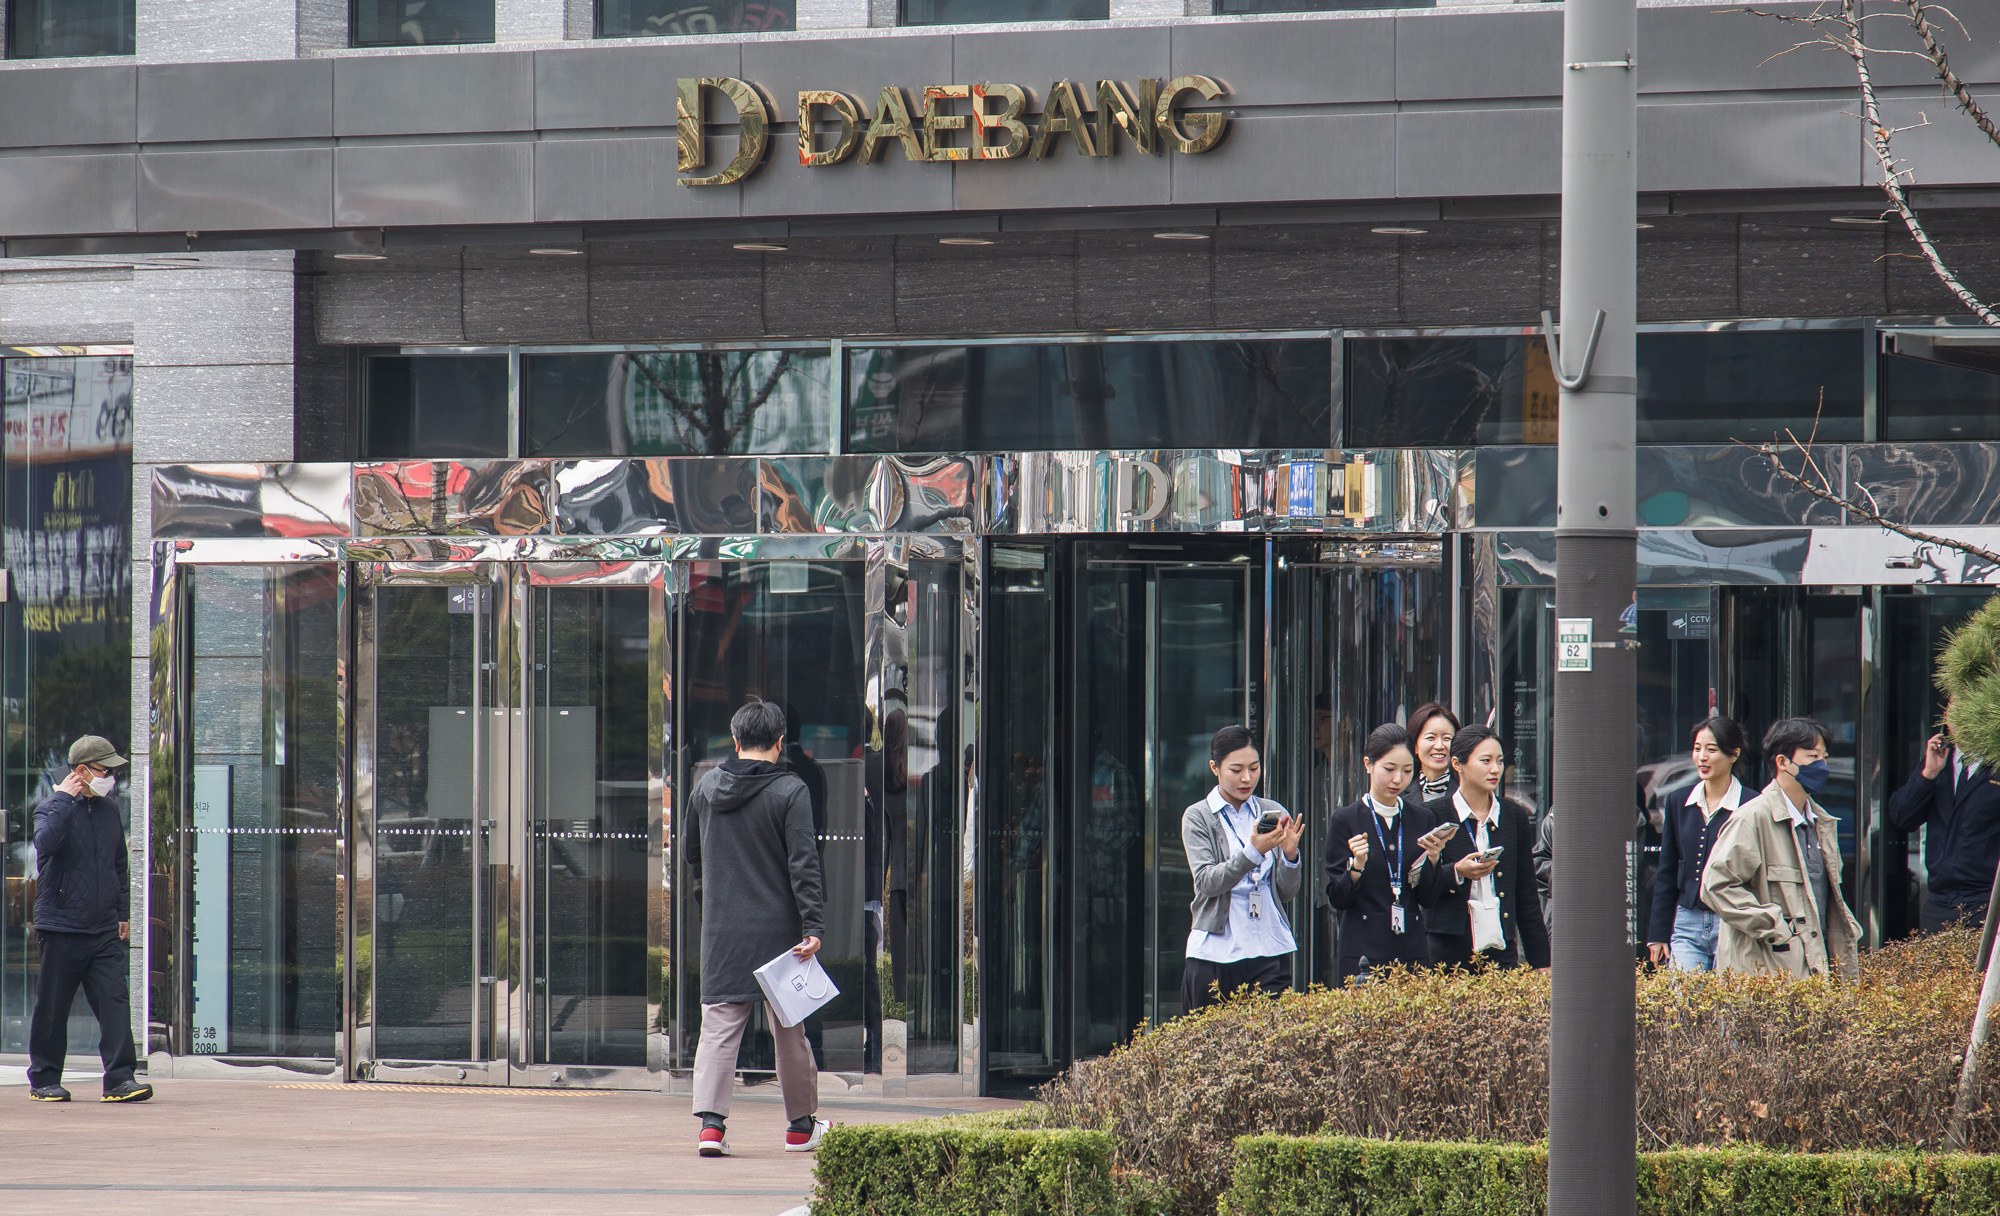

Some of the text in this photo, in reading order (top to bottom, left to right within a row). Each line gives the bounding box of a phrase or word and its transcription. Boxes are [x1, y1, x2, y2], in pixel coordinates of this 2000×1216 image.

[799, 74, 1230, 167] DAEBANG
[1690, 615, 1710, 623] CCTV
[1566, 644, 1580, 657] 62
[203, 1026, 217, 1039] 3층
[194, 1042, 218, 1054] 2080
